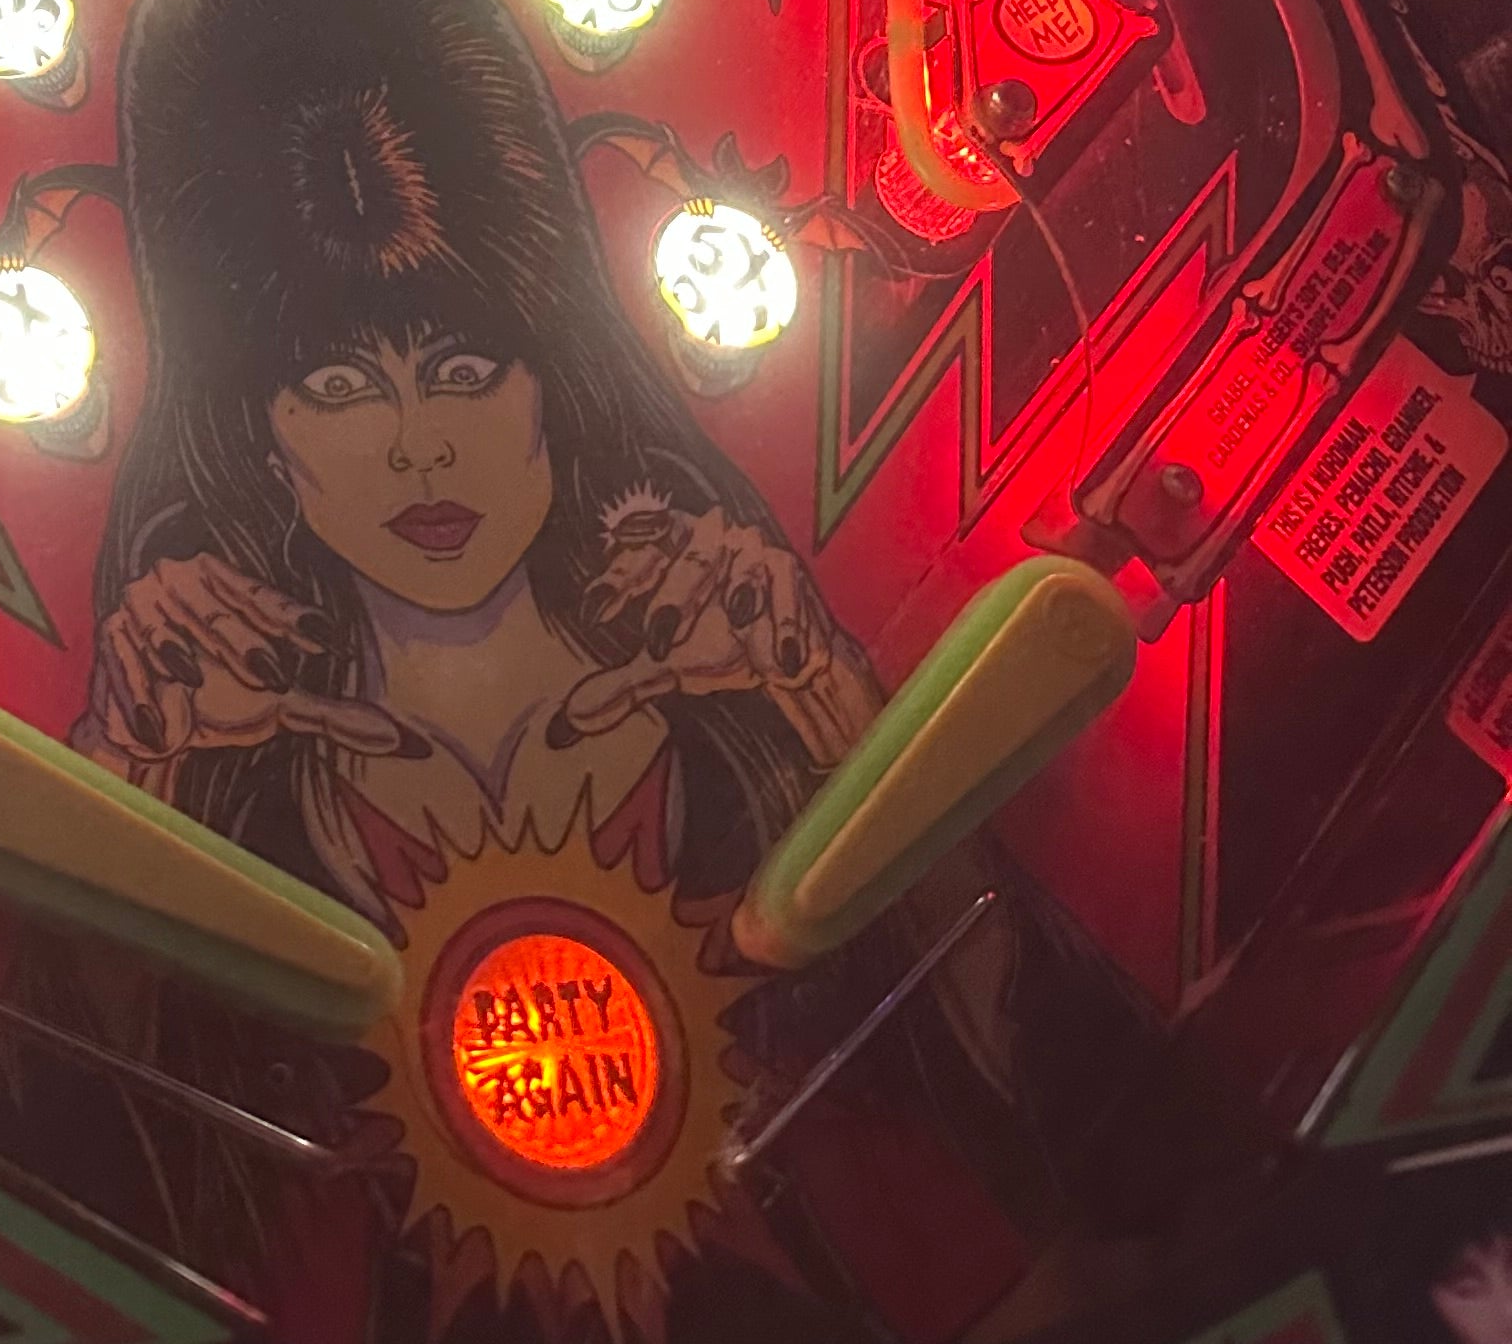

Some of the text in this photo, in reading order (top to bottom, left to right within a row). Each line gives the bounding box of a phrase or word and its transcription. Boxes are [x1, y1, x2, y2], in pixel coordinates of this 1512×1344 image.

[687, 223, 771, 293] 5X
[1207, 392, 1271, 469] CARDENAS
[1261, 381, 1279, 399] &
[1423, 432, 1447, 456] &
[1268, 502, 1306, 539] THIS
[1292, 488, 1316, 518] IS
[1394, 463, 1468, 554] PRODUCTION
[473, 973, 613, 1044] PARTY
[492, 1052, 639, 1125] AGAIN
